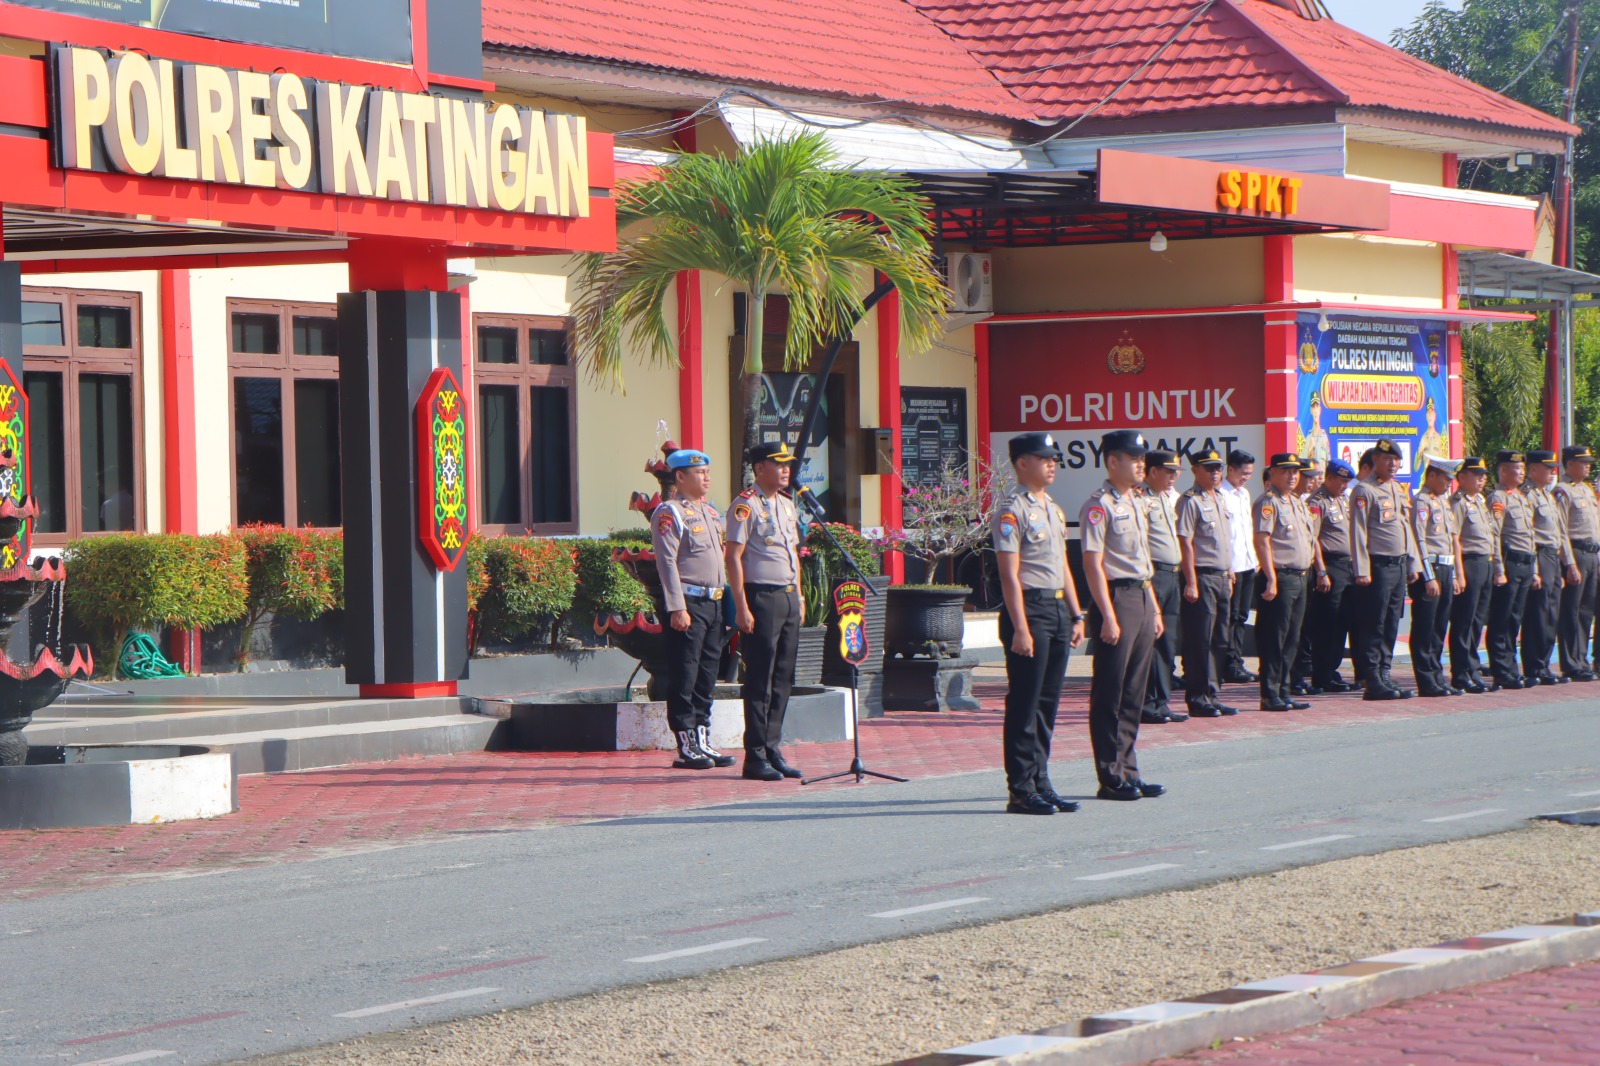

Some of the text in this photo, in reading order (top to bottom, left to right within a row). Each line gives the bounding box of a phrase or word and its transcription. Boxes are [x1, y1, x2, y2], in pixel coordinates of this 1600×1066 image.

[101, 1, 122, 10] TENGAH
[62, 47, 590, 218] POLRES KATINGAN
[1220, 169, 1303, 215] SPKT
[1329, 321, 1420, 334] POLISIAN NEGARA REPUBLIK INDONESIA
[1337, 334, 1407, 346] DAERAH KALIMANTAN TENGAH
[1331, 348, 1414, 372] POLRES KATINGAN
[1328, 381, 1418, 404] WILAYAH ZONA INTEGRITAS
[1020, 388, 1236, 423] POLRI UNTUK
[841, 584, 860, 592] POLRES
